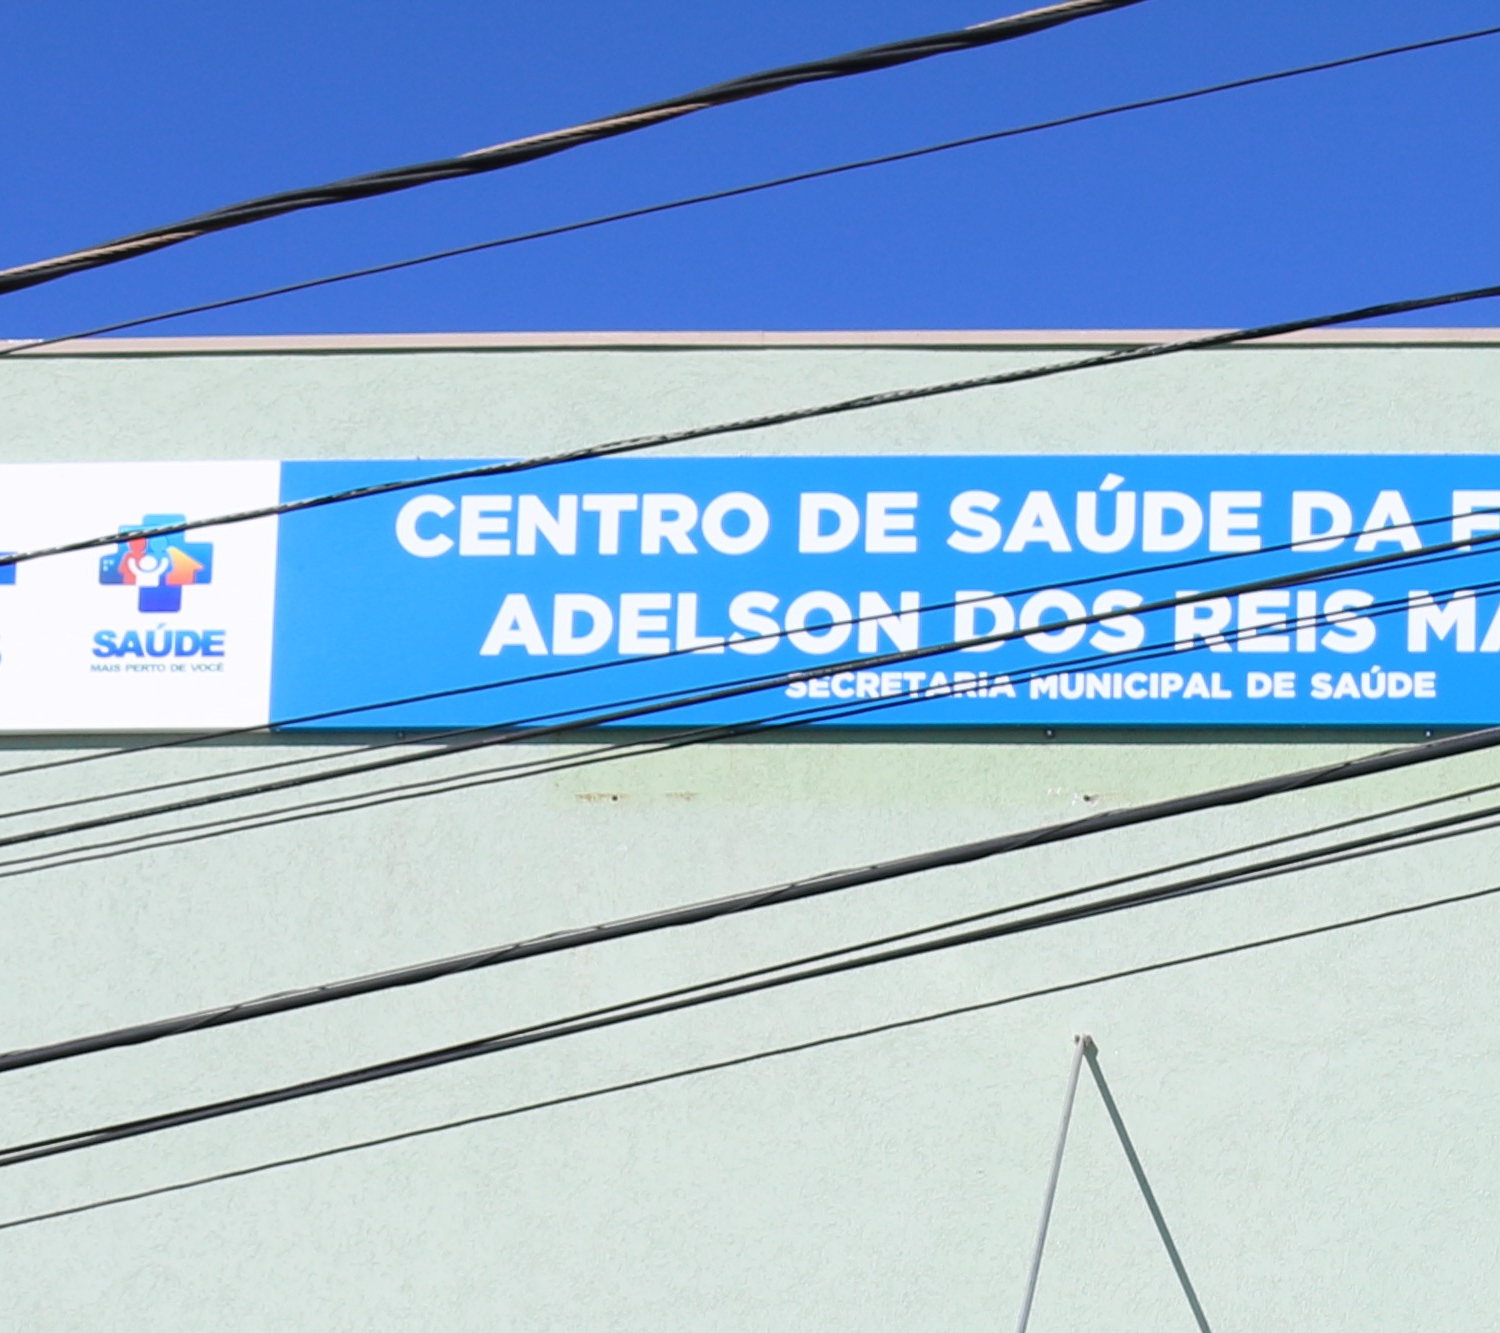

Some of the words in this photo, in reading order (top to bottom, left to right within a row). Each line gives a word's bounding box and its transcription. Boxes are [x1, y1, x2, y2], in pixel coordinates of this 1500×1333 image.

[396, 491, 770, 558] CENTRO
[798, 491, 918, 555] DE
[946, 473, 1262, 555] SAÚDE
[1291, 490, 1423, 553] DA
[92, 622, 227, 658] SAÚDE
[479, 590, 920, 656] ADELSON
[953, 588, 1146, 655] DOS
[1173, 588, 1377, 654] REIS
[90, 663, 121, 673] MAIS
[126, 663, 166, 673] PERTO
[170, 663, 186, 673] DE
[191, 661, 225, 673] VOCÊ
[785, 671, 1017, 699] SECRETARIA
[1029, 671, 1232, 699] MUNICIPAL
[1247, 672, 1295, 698] DE
[1310, 665, 1437, 699] SAÚDE
